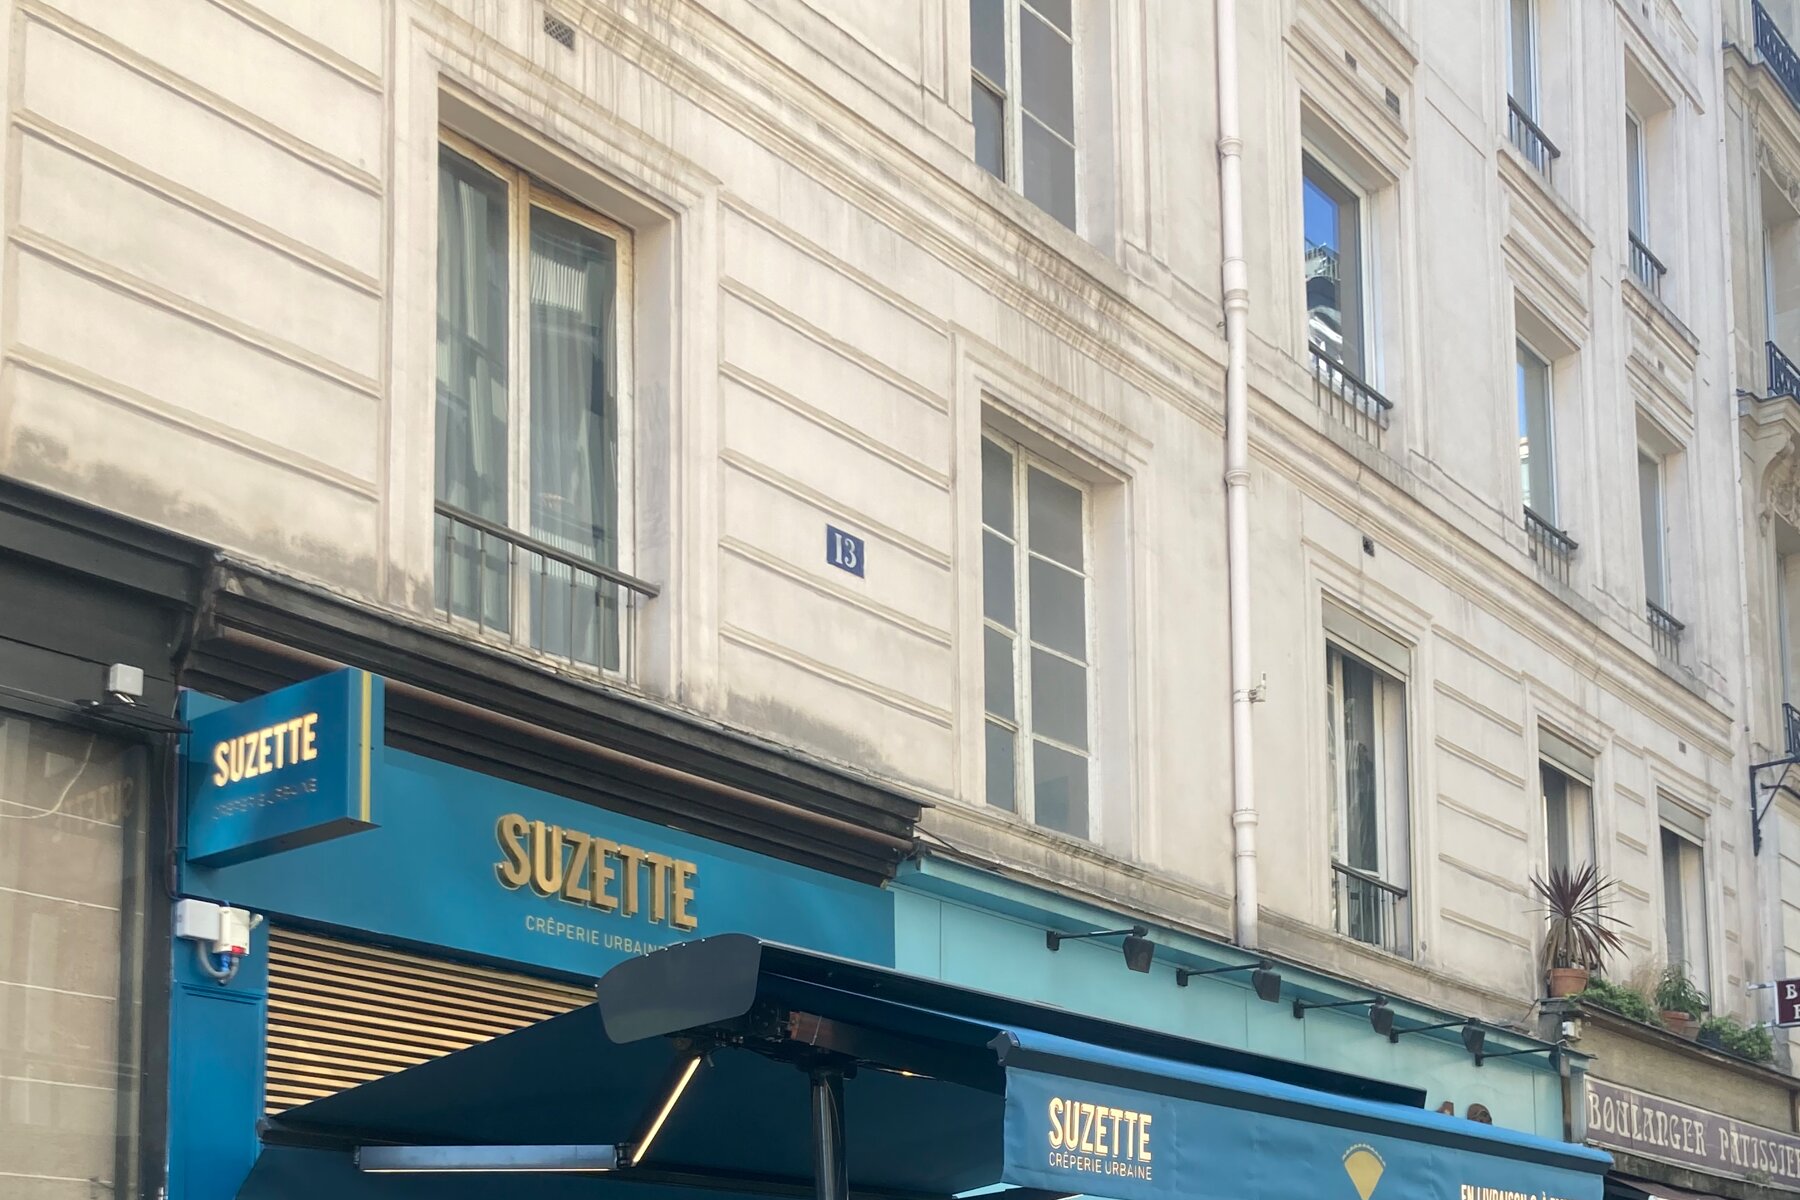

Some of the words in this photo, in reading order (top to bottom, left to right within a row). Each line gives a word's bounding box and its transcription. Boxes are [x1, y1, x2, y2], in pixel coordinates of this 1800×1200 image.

[835, 532, 857, 568] 13
[213, 711, 319, 787] SUZETTE
[495, 813, 698, 931] SUZETTE
[525, 916, 600, 945] CRÊPERIE
[604, 934, 668, 956] URBAIN
[1048, 1097, 1152, 1163] SUZETTE
[1589, 1091, 1707, 1157] BOULANGER
[1105, 1161, 1152, 1181] URBAINE
